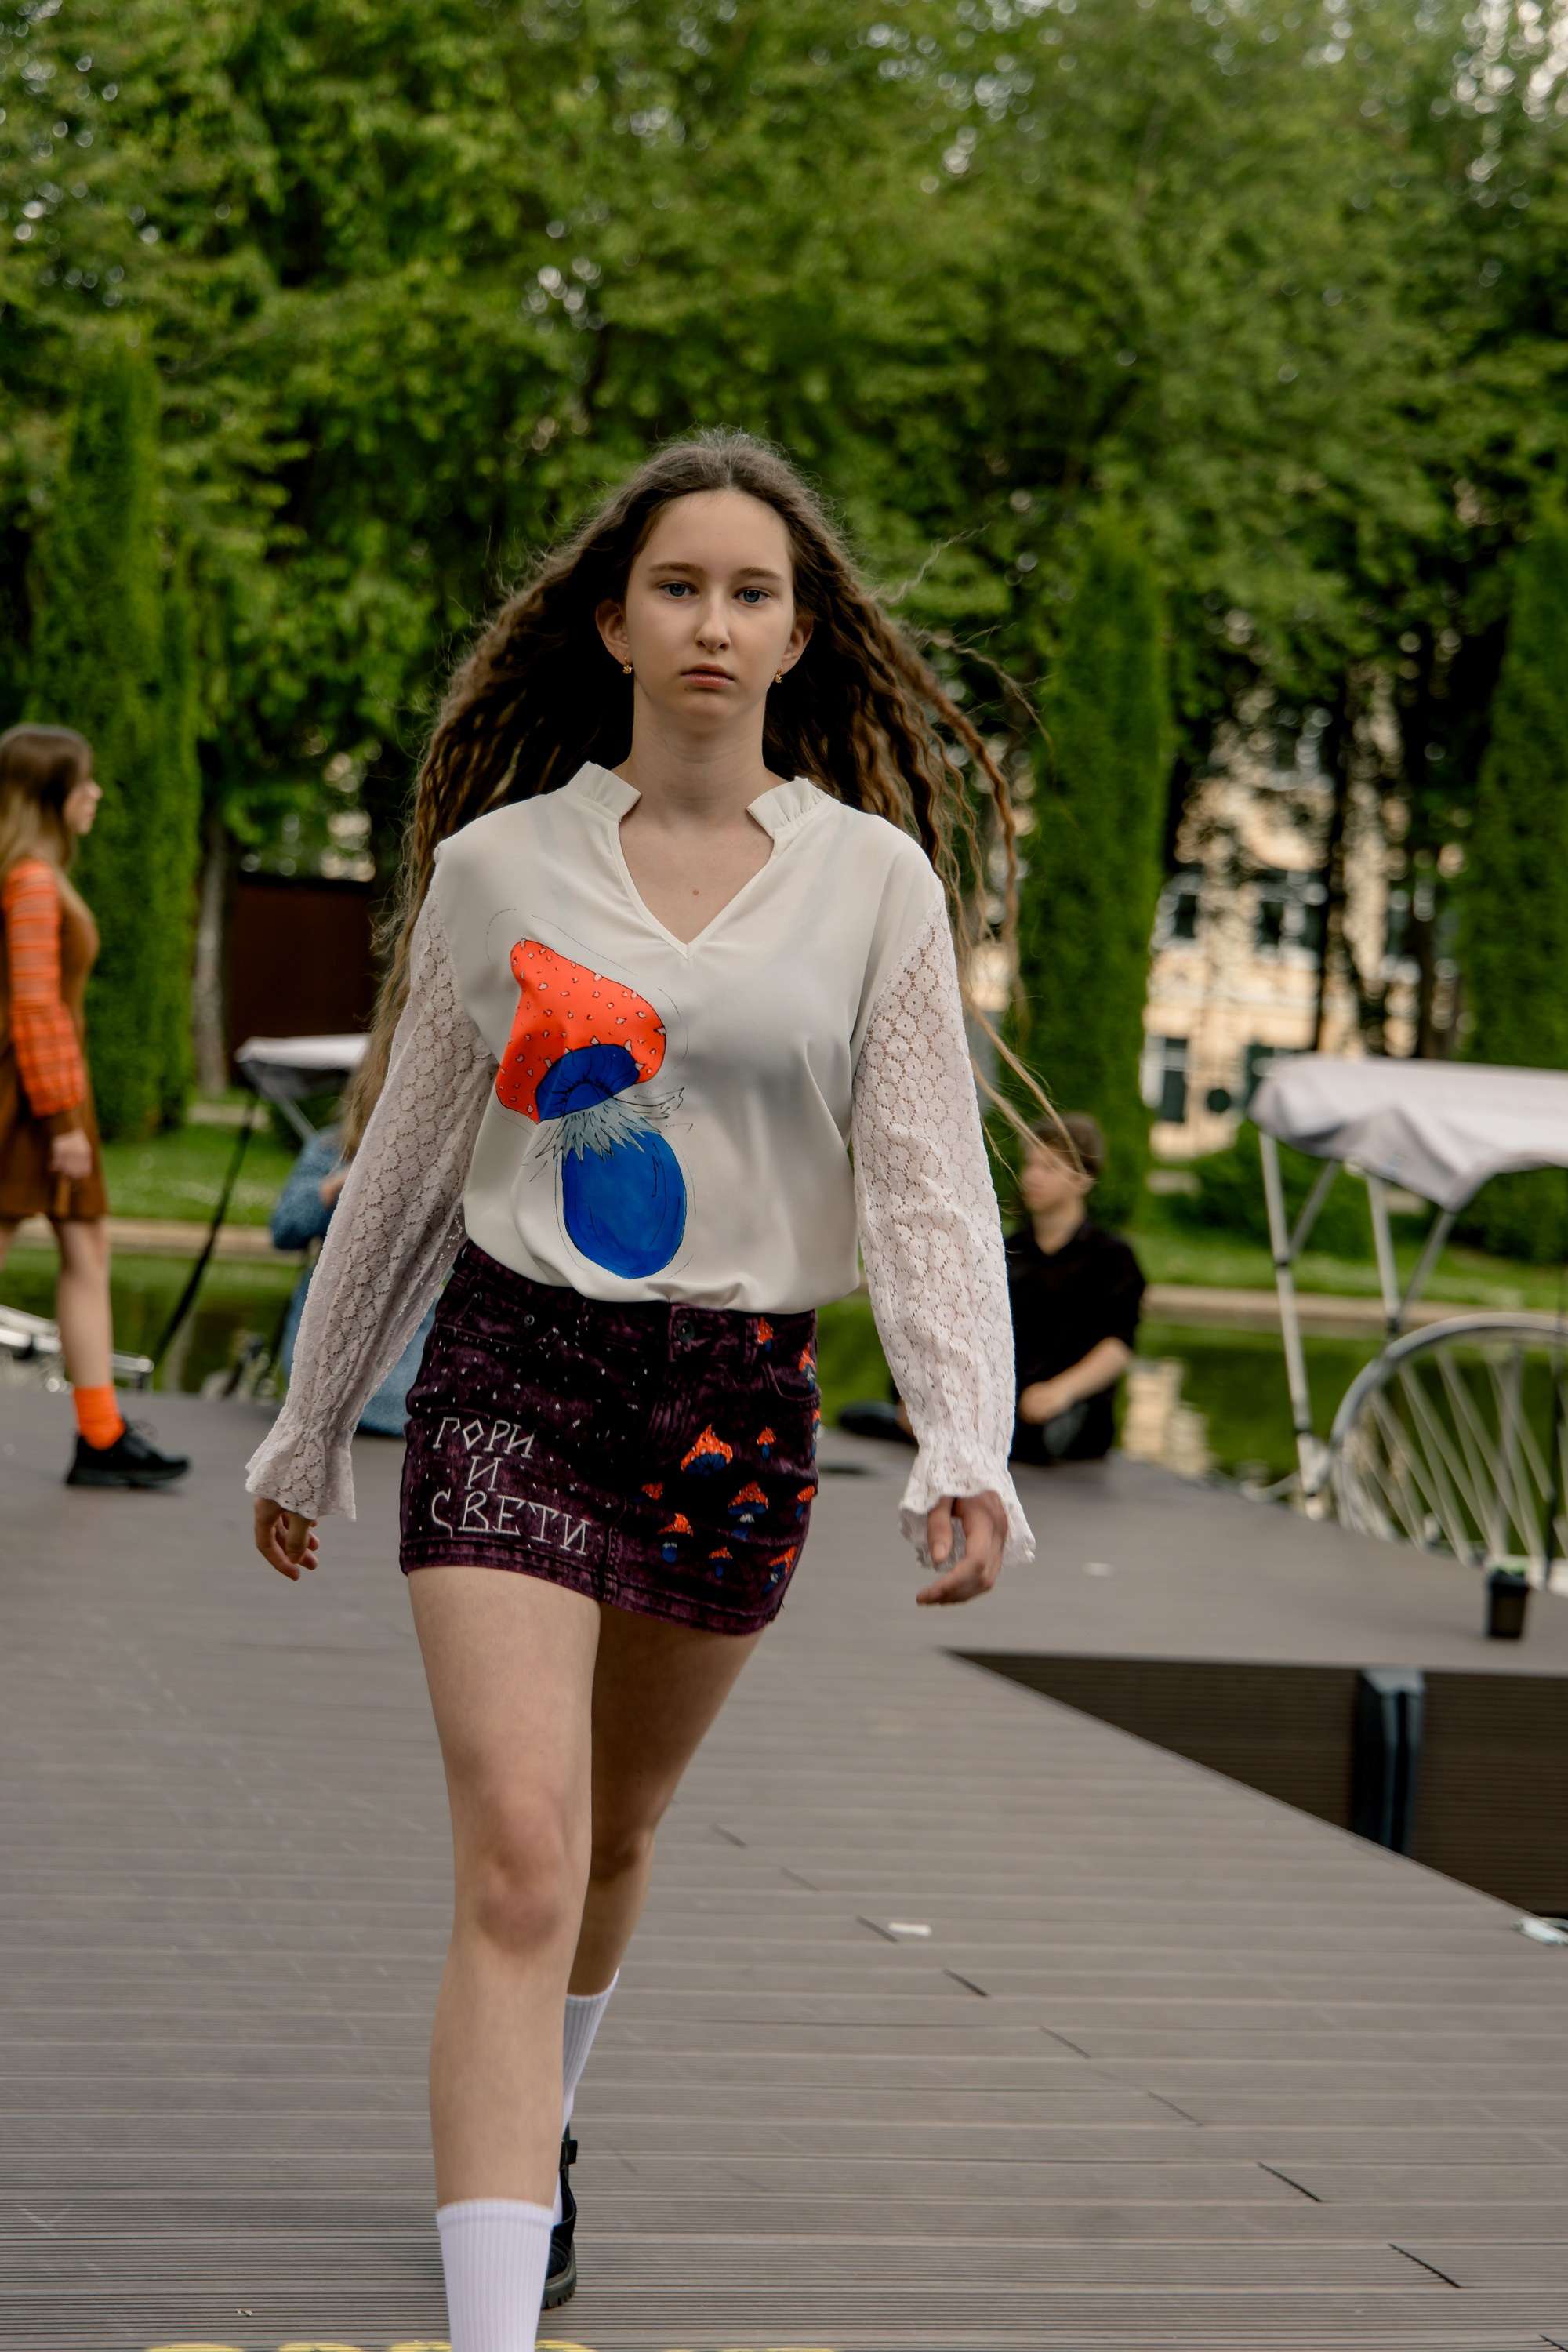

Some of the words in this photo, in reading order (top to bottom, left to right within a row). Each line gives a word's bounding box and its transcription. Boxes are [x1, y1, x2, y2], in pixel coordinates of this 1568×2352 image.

[433, 1417, 534, 1457] ГОРИ
[464, 1456, 503, 1491] И
[431, 1488, 591, 1555] СВЕТИ
